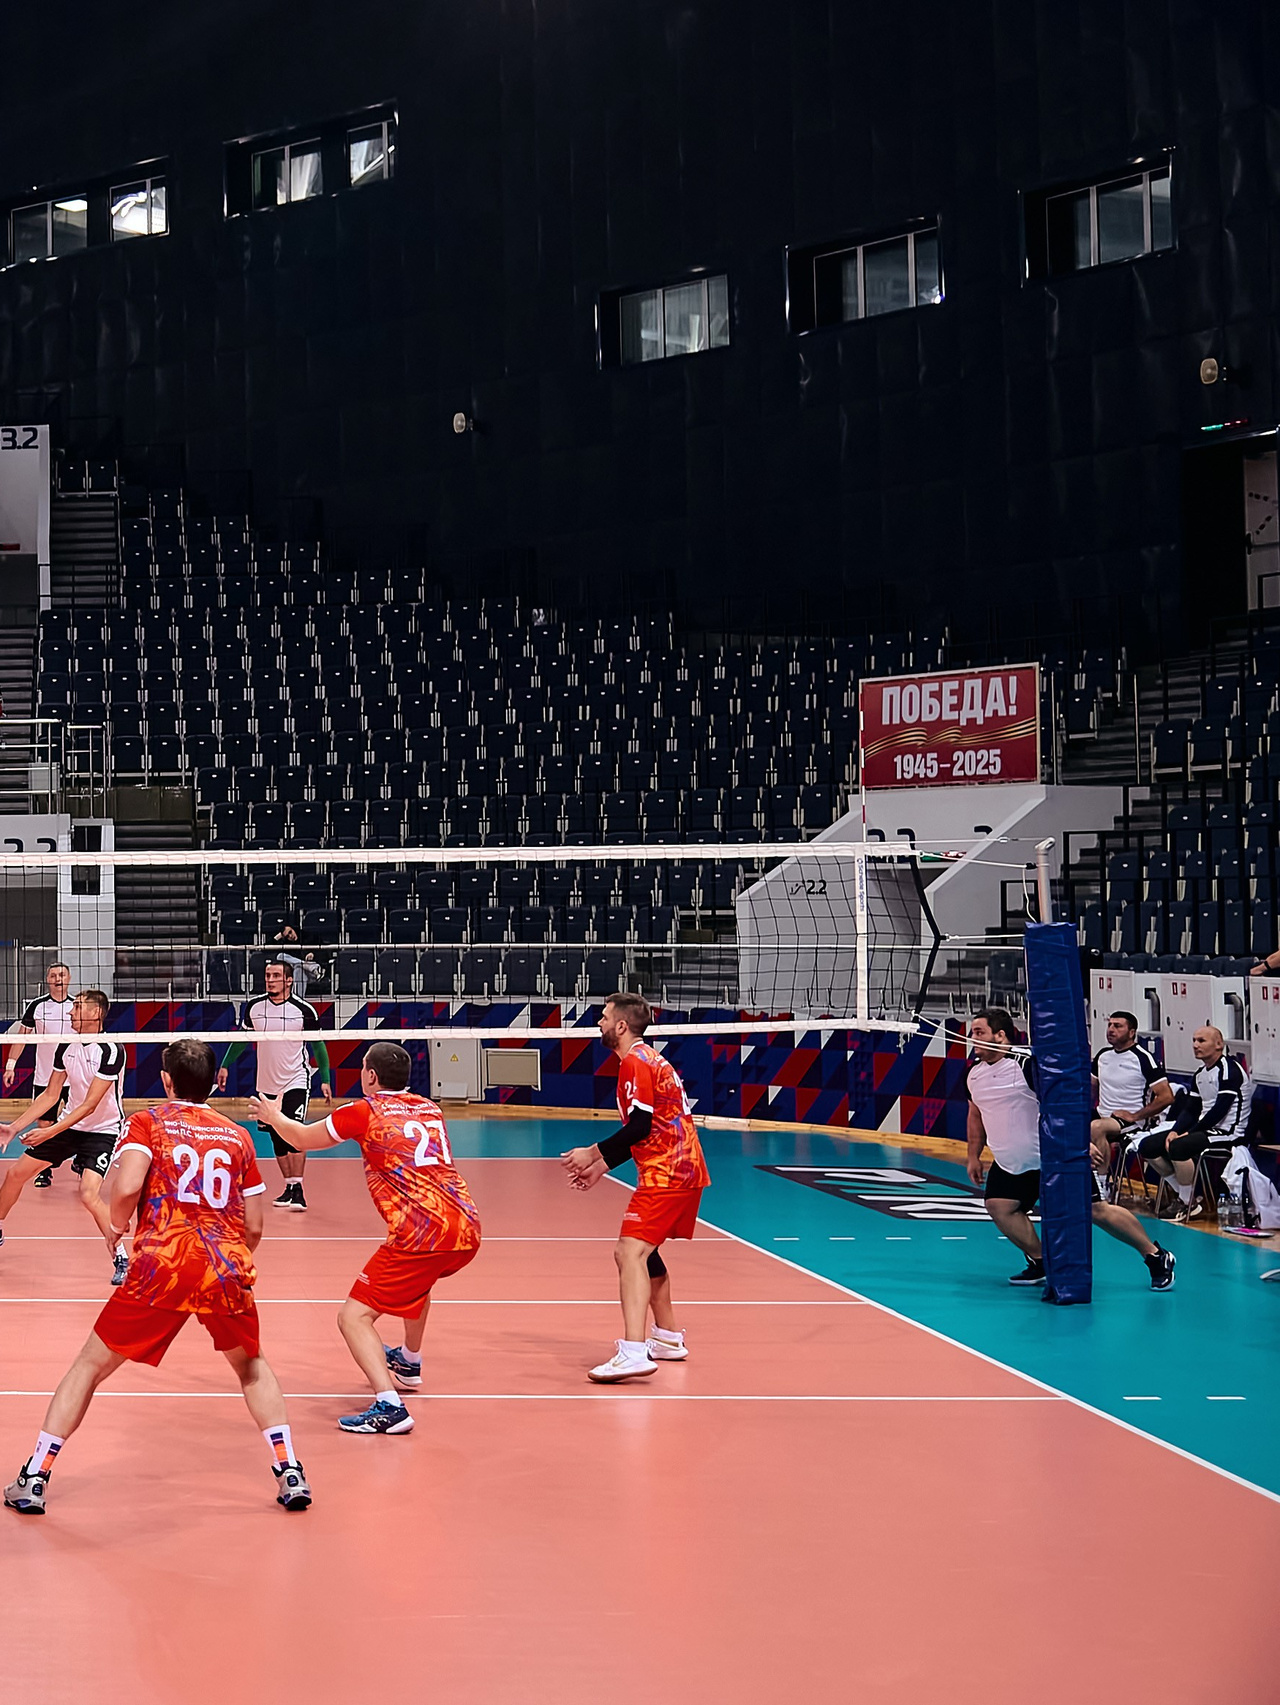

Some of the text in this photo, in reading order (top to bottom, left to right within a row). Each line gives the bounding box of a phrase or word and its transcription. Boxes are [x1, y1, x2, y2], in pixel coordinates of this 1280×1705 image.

[881, 675, 1018, 726] ПОБЕДА!
[806, 879, 827, 895] 2.2
[403, 1120, 452, 1167] 27
[172, 1144, 232, 1209] 26
